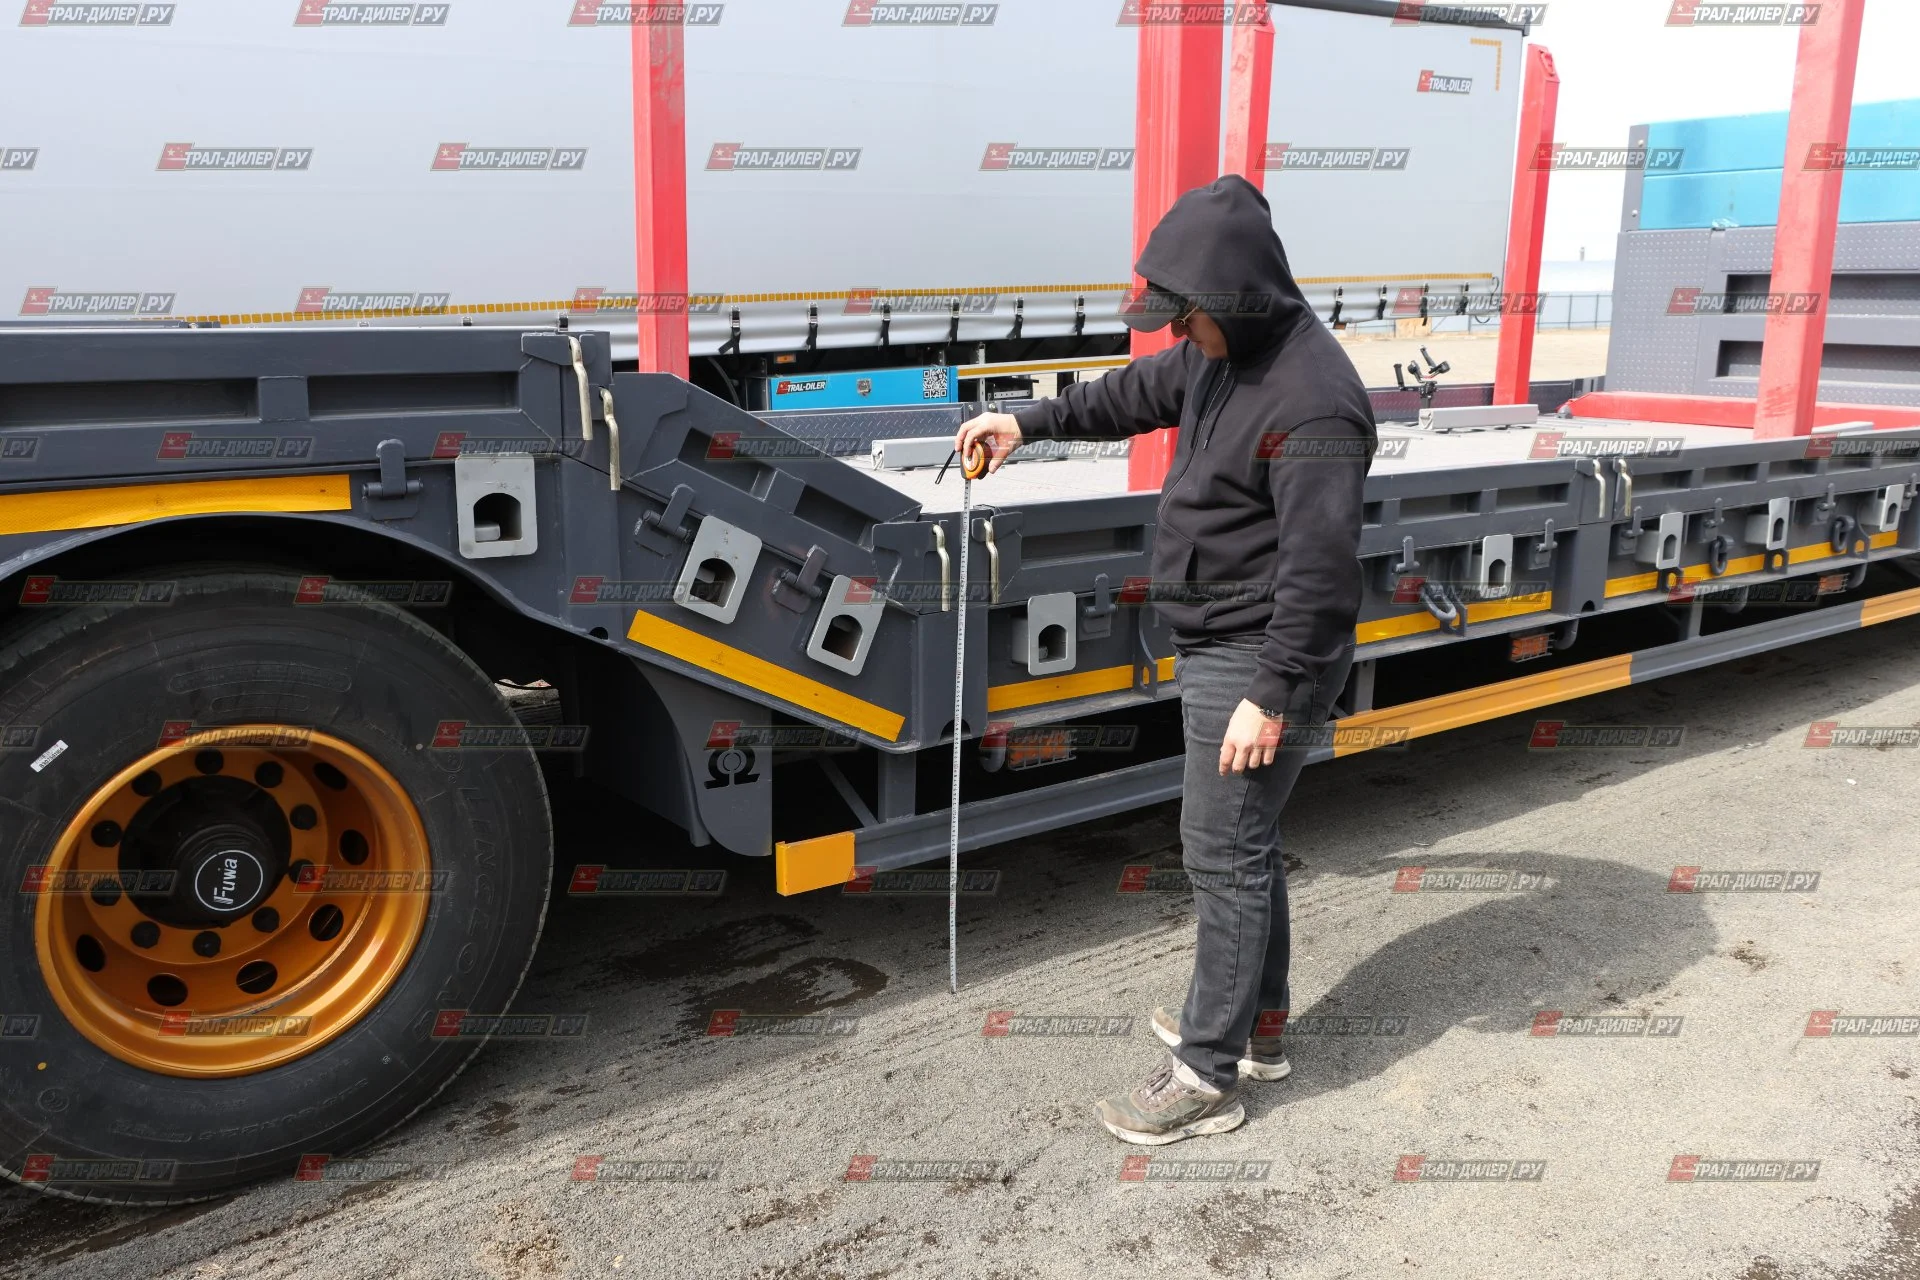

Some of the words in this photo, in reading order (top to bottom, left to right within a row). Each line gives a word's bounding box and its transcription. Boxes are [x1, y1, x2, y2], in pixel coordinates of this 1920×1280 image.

[1429, 77, 1472, 93] TRAL-DILER
[787, 381, 827, 393] TRAL-DILER
[213, 858, 238, 905] Fuwa
